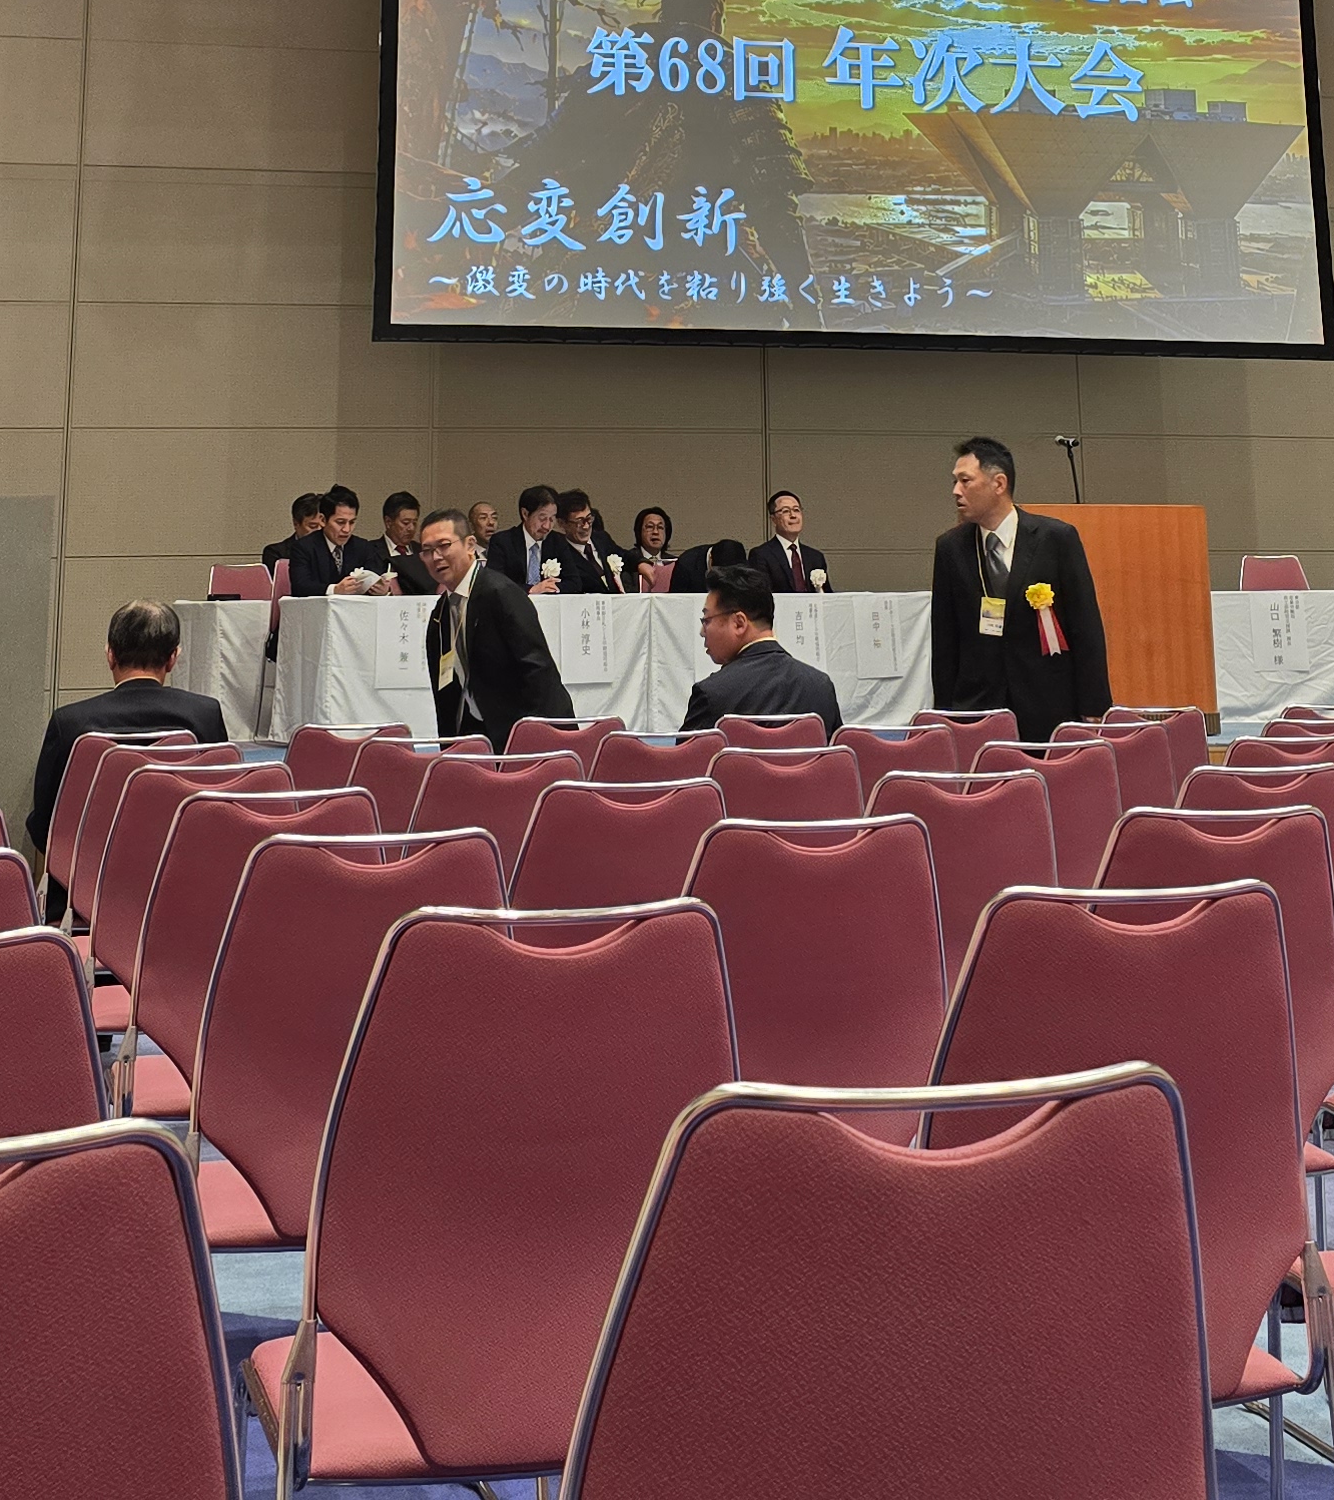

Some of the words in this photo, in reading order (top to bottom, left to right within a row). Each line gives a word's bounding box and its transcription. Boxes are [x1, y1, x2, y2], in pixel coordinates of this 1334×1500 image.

[586, 26, 797, 103] 第68回
[822, 25, 1145, 122] 年次大会
[426, 177, 747, 256] 応変創新
